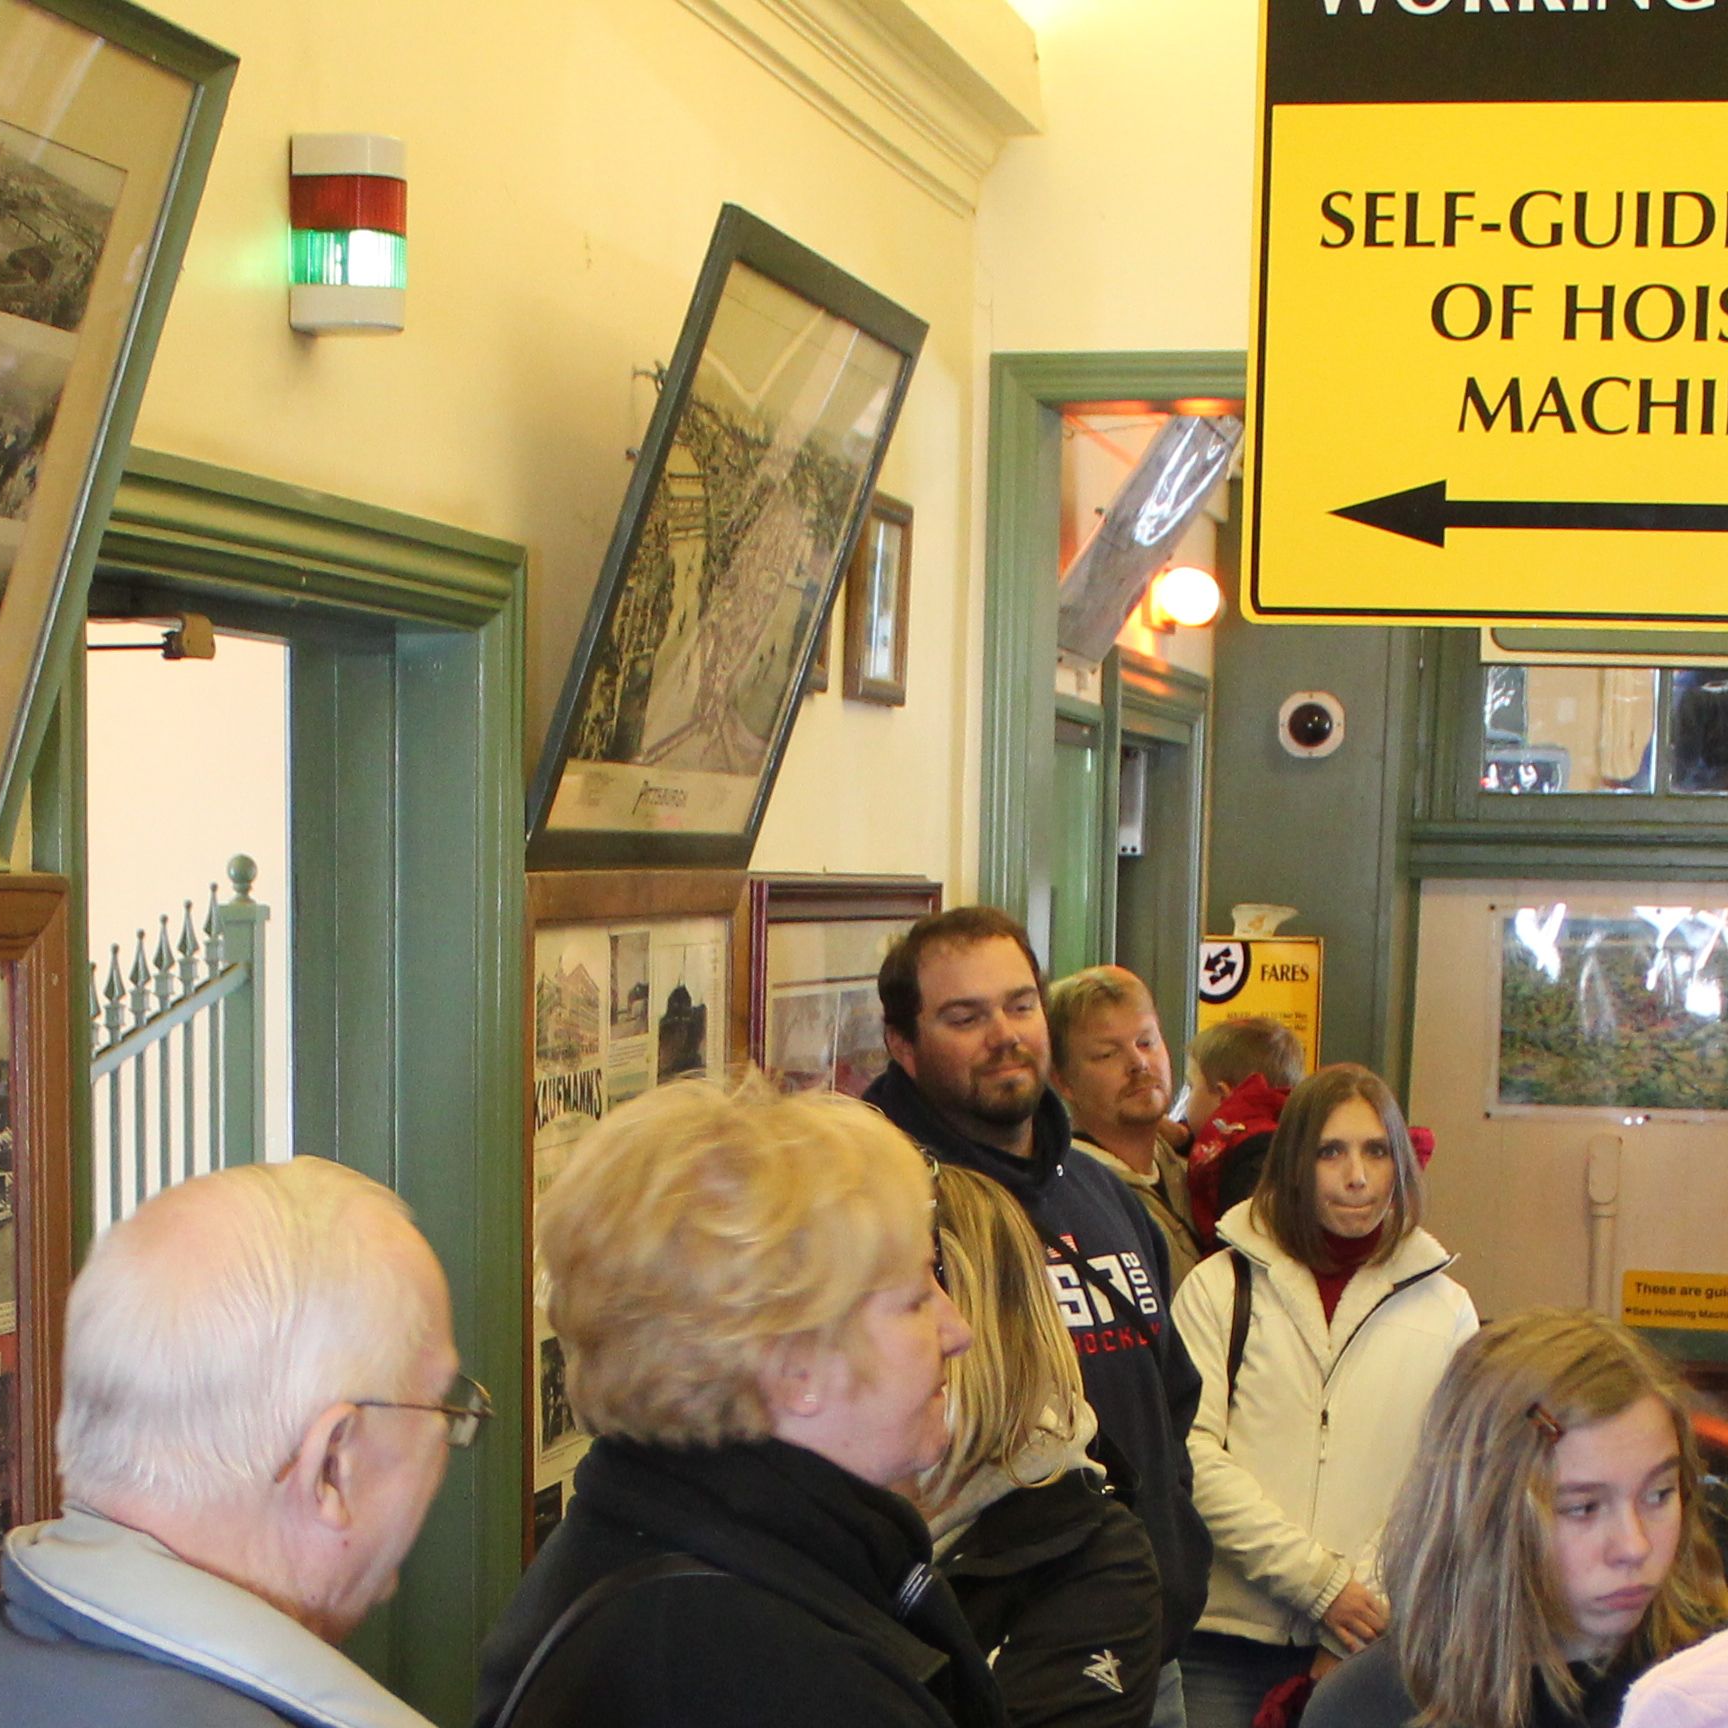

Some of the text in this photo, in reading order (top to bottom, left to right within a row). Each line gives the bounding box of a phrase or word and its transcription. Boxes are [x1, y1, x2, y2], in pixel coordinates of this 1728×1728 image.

[1430, 283, 1533, 342] OF
[1260, 963, 1309, 982] FARES
[1120, 1251, 1158, 1315] 2010
[1635, 1281, 1677, 1296] These
[1680, 1287, 1701, 1297] are
[1633, 1307, 1652, 1316] See
[1654, 1307, 1696, 1320] Hoisting
